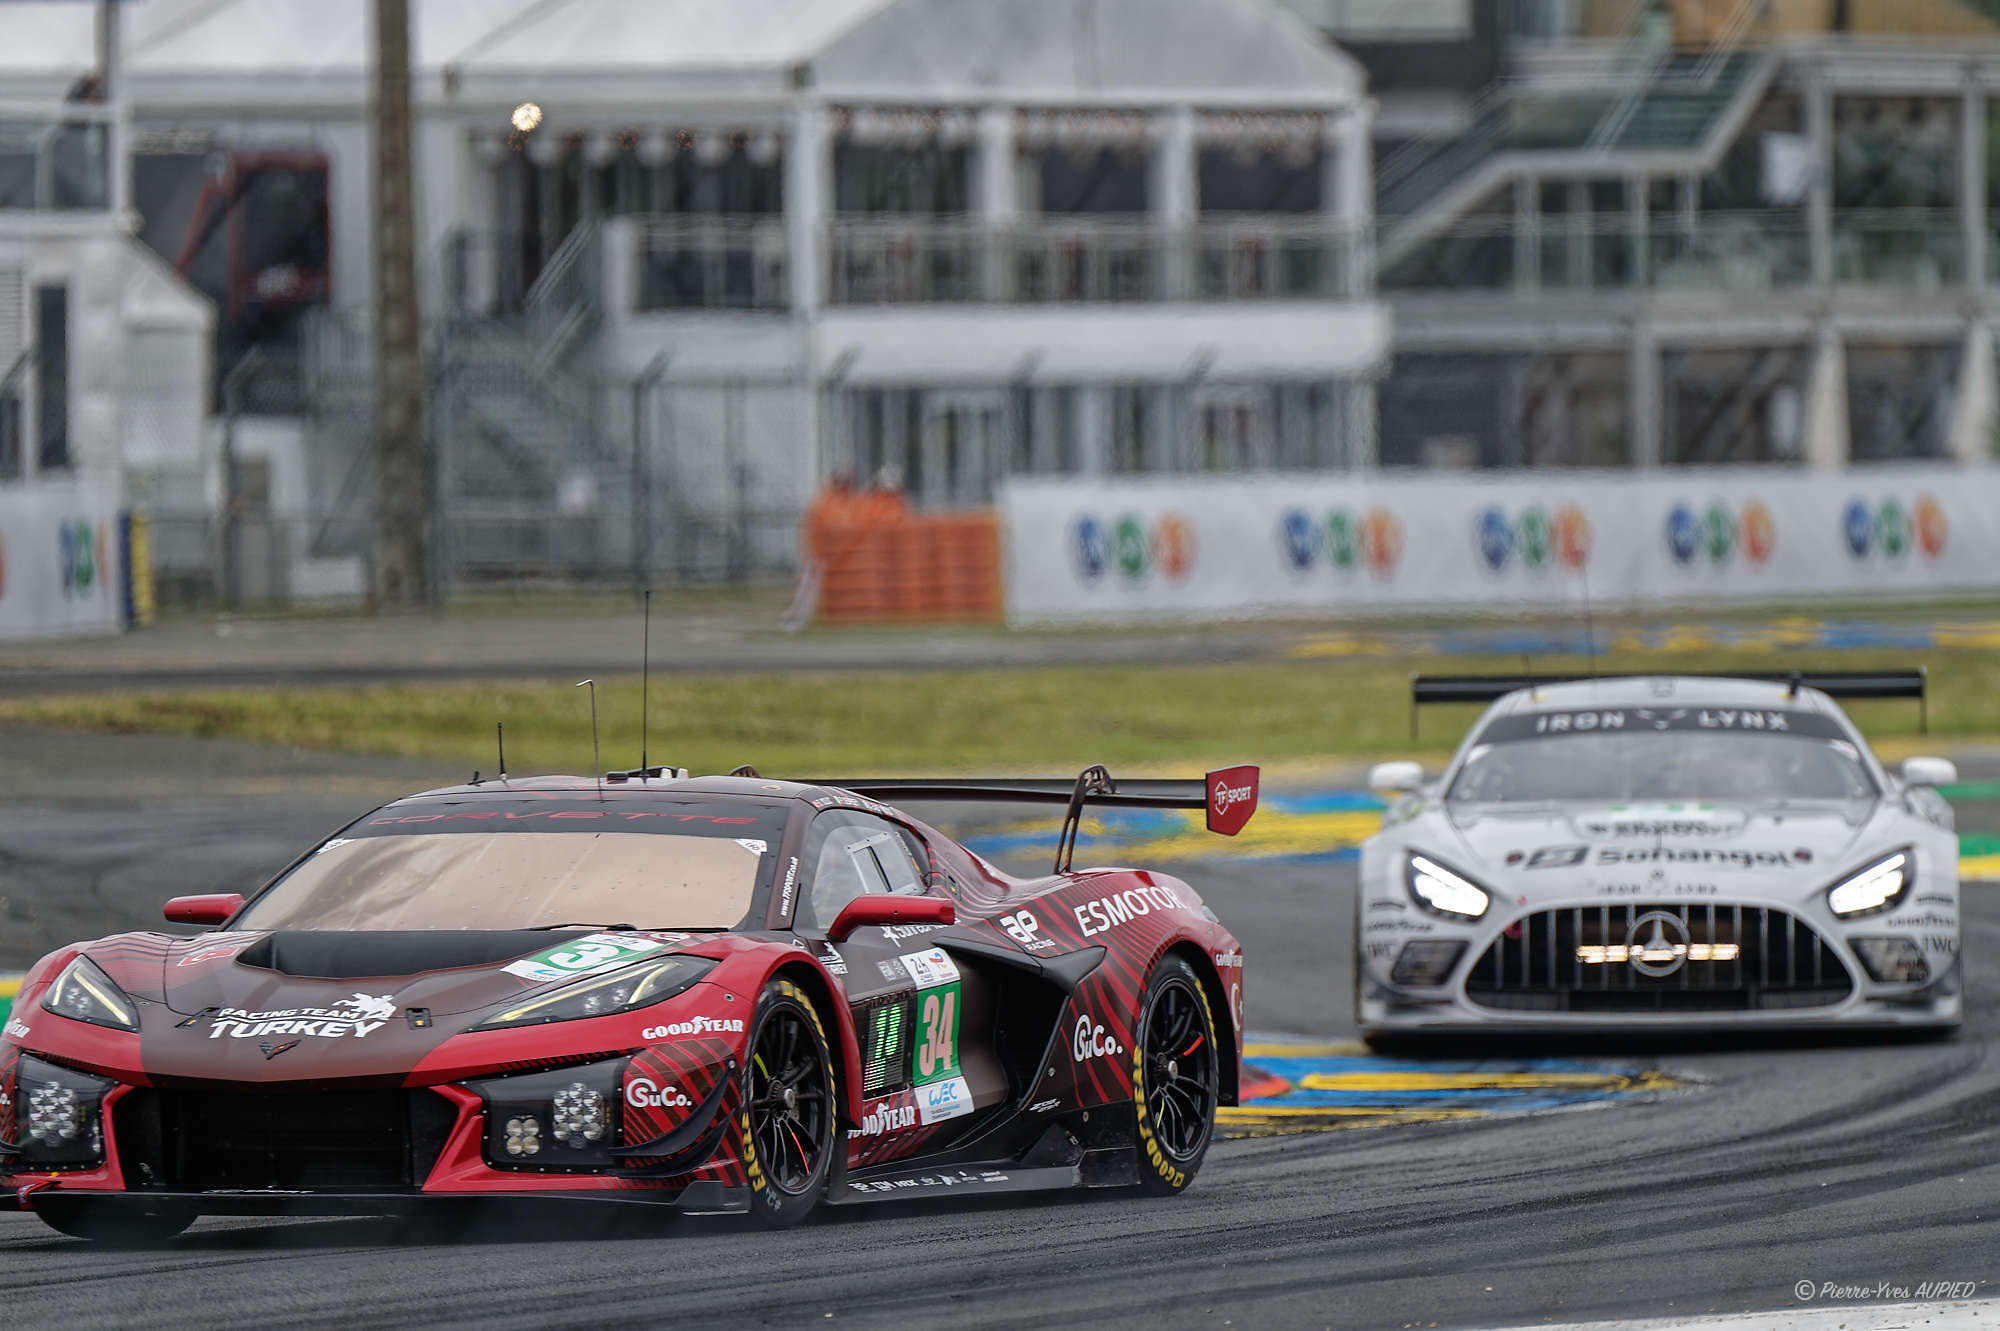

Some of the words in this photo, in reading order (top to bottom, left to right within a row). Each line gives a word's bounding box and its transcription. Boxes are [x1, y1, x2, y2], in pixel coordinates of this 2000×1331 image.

[1536, 711, 1625, 733] IRON
[1699, 710, 1790, 731] LYNX
[1228, 786, 1251, 803] SPORT
[368, 811, 758, 825] CORVETTE
[1025, 939, 1056, 952] RACING
[218, 1008, 297, 1020] RACING
[301, 1008, 360, 1020] TEAM
[209, 1020, 386, 1039] TURKEY
[642, 1016, 744, 1039] GOODYEAR
[920, 991, 955, 1076] 34
[929, 1082, 958, 1106] WEC
